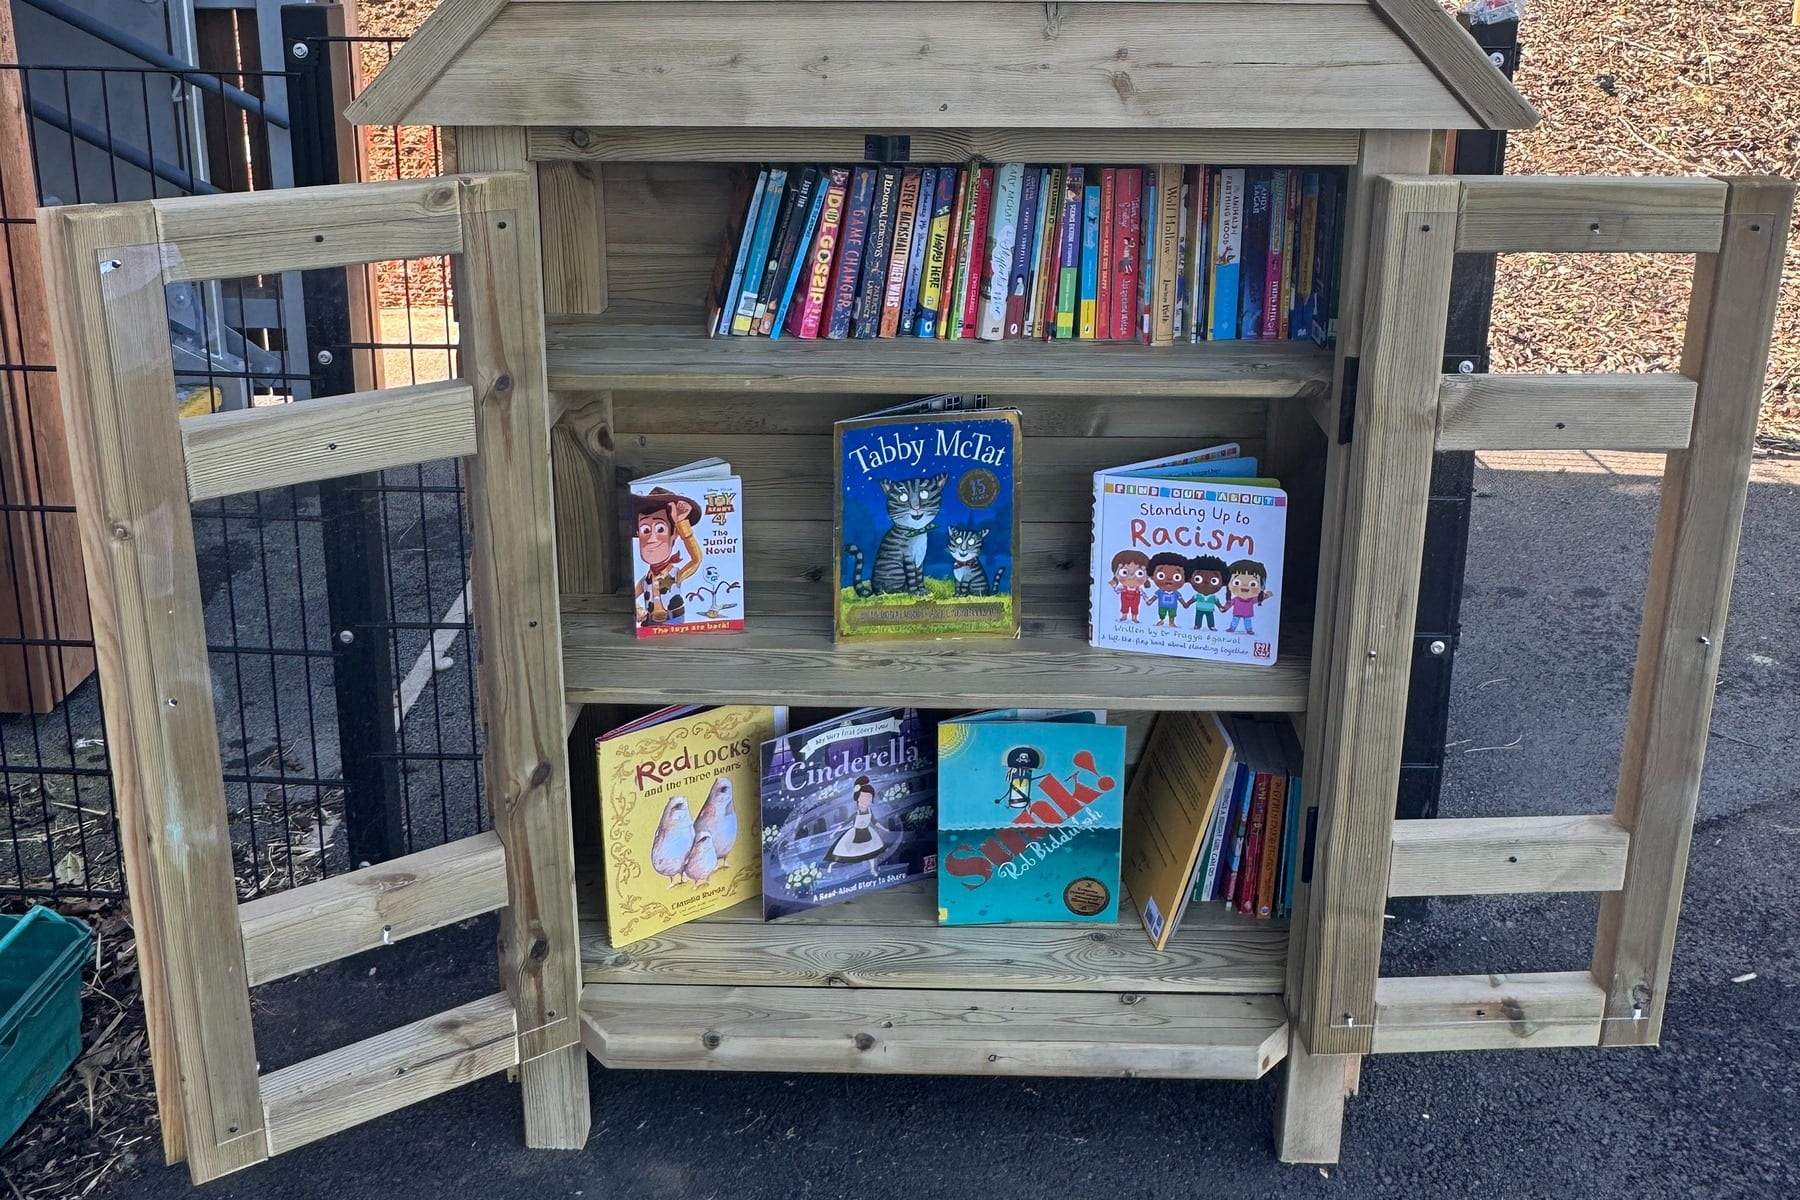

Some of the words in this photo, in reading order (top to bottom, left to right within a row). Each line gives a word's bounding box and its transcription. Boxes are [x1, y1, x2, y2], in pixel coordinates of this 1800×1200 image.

[901, 183, 917, 209] STEVE
[1166, 186, 1178, 211] Wolf
[1224, 175, 1233, 216] FARTHING
[1252, 185, 1260, 214] SAGAR
[1260, 187, 1268, 212] ANDY
[821, 188, 845, 233] IDOL
[1231, 195, 1240, 229] ANIMALS
[847, 209, 866, 246] GAME
[874, 219, 888, 258] DETECTIVES
[894, 211, 914, 256] BACKSHALL
[1164, 215, 1176, 256] Hollow
[1222, 219, 1231, 245] WOOD
[809, 235, 834, 305] GOSSIP
[838, 250, 860, 309] CHANGER
[891, 259, 905, 283] TIGER
[863, 280, 874, 319] LAWRENCE
[887, 283, 902, 308] WARS
[849, 433, 925, 474] Tabby
[934, 429, 1006, 467] McTat
[704, 492, 737, 506] TOY
[970, 478, 988, 494] 15
[1116, 484, 1158, 496] FIND
[1173, 488, 1204, 499] OUT
[1217, 491, 1274, 506] ABOUT
[711, 512, 727, 526] 4
[1140, 502, 1206, 523] Standing
[1212, 506, 1231, 525] Up
[1236, 508, 1251, 525] to
[702, 537, 739, 547] Junior
[712, 529, 729, 537] The
[1130, 519, 1255, 555] Racism
[705, 545, 737, 555] Novel
[652, 626, 669, 634] The
[671, 625, 690, 634] toys
[706, 621, 731, 630] back!
[1114, 625, 1145, 634] Written
[1148, 627, 1158, 638] by
[1150, 639, 1166, 647] book
[1168, 641, 1187, 649] about
[1189, 643, 1219, 655] standing
[1220, 647, 1249, 656] together
[856, 726, 874, 736] Story
[784, 736, 919, 792] Cinderella
[644, 784, 663, 798] and
[666, 780, 682, 792] the
[684, 771, 711, 786] Three
[714, 761, 742, 776] Bears
[945, 750, 1115, 891] Sunk!
[998, 852, 1035, 880] Rob
[1026, 806, 1103, 860] Biddulph
[1208, 866, 1215, 877] DO
[1210, 852, 1218, 866] CAN
[813, 894, 819, 902] A
[858, 879, 877, 890] Story
[878, 877, 886, 885] to
[886, 873, 907, 883] Share
